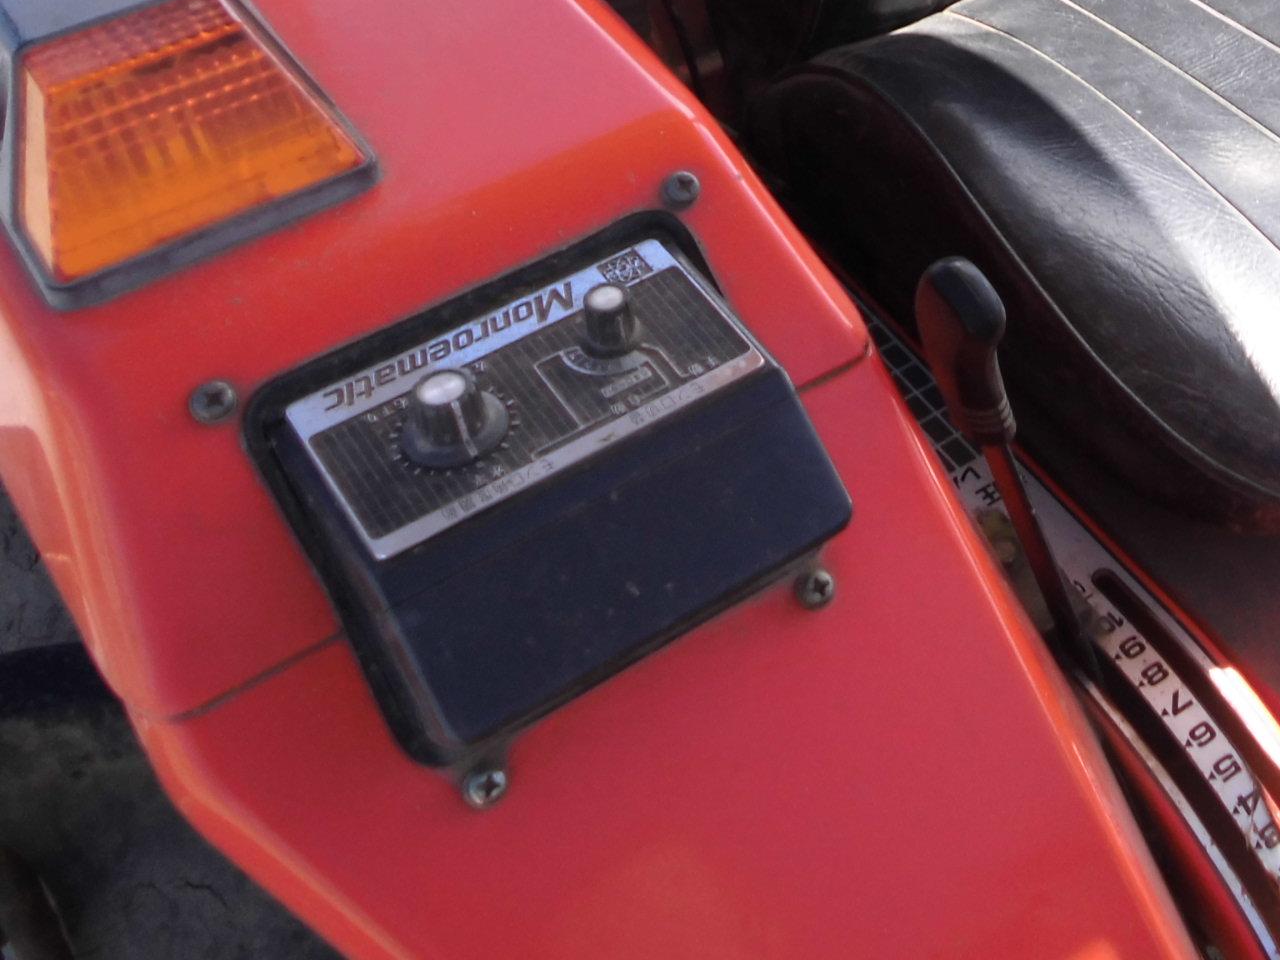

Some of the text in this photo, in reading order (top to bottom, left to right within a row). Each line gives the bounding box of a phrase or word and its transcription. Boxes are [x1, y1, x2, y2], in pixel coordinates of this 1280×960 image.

[323, 281, 574, 412] Monroematic
[1119, 635, 1147, 659] 9
[1141, 661, 1170, 687] 8
[1171, 689, 1194, 717] 7
[1188, 720, 1217, 748] 6
[1213, 754, 1242, 783] 5
[1237, 790, 1261, 816] 4
